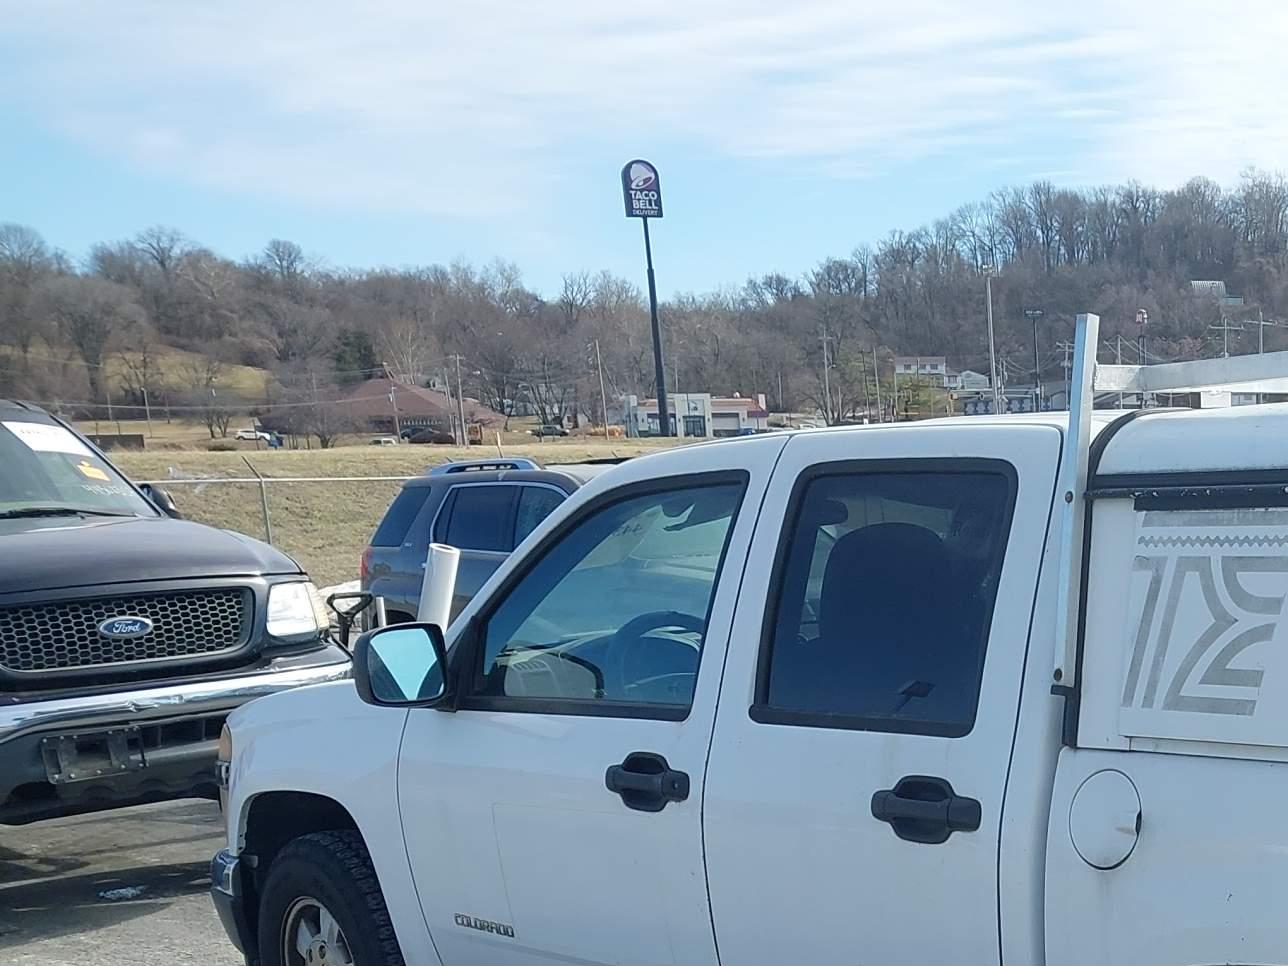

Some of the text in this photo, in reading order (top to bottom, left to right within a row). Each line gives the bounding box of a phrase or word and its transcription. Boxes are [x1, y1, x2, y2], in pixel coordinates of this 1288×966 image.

[629, 190, 658, 200] TACO
[632, 199, 659, 210] BELL
[112, 620, 141, 634] Ford
[454, 913, 515, 938] COLORADO
